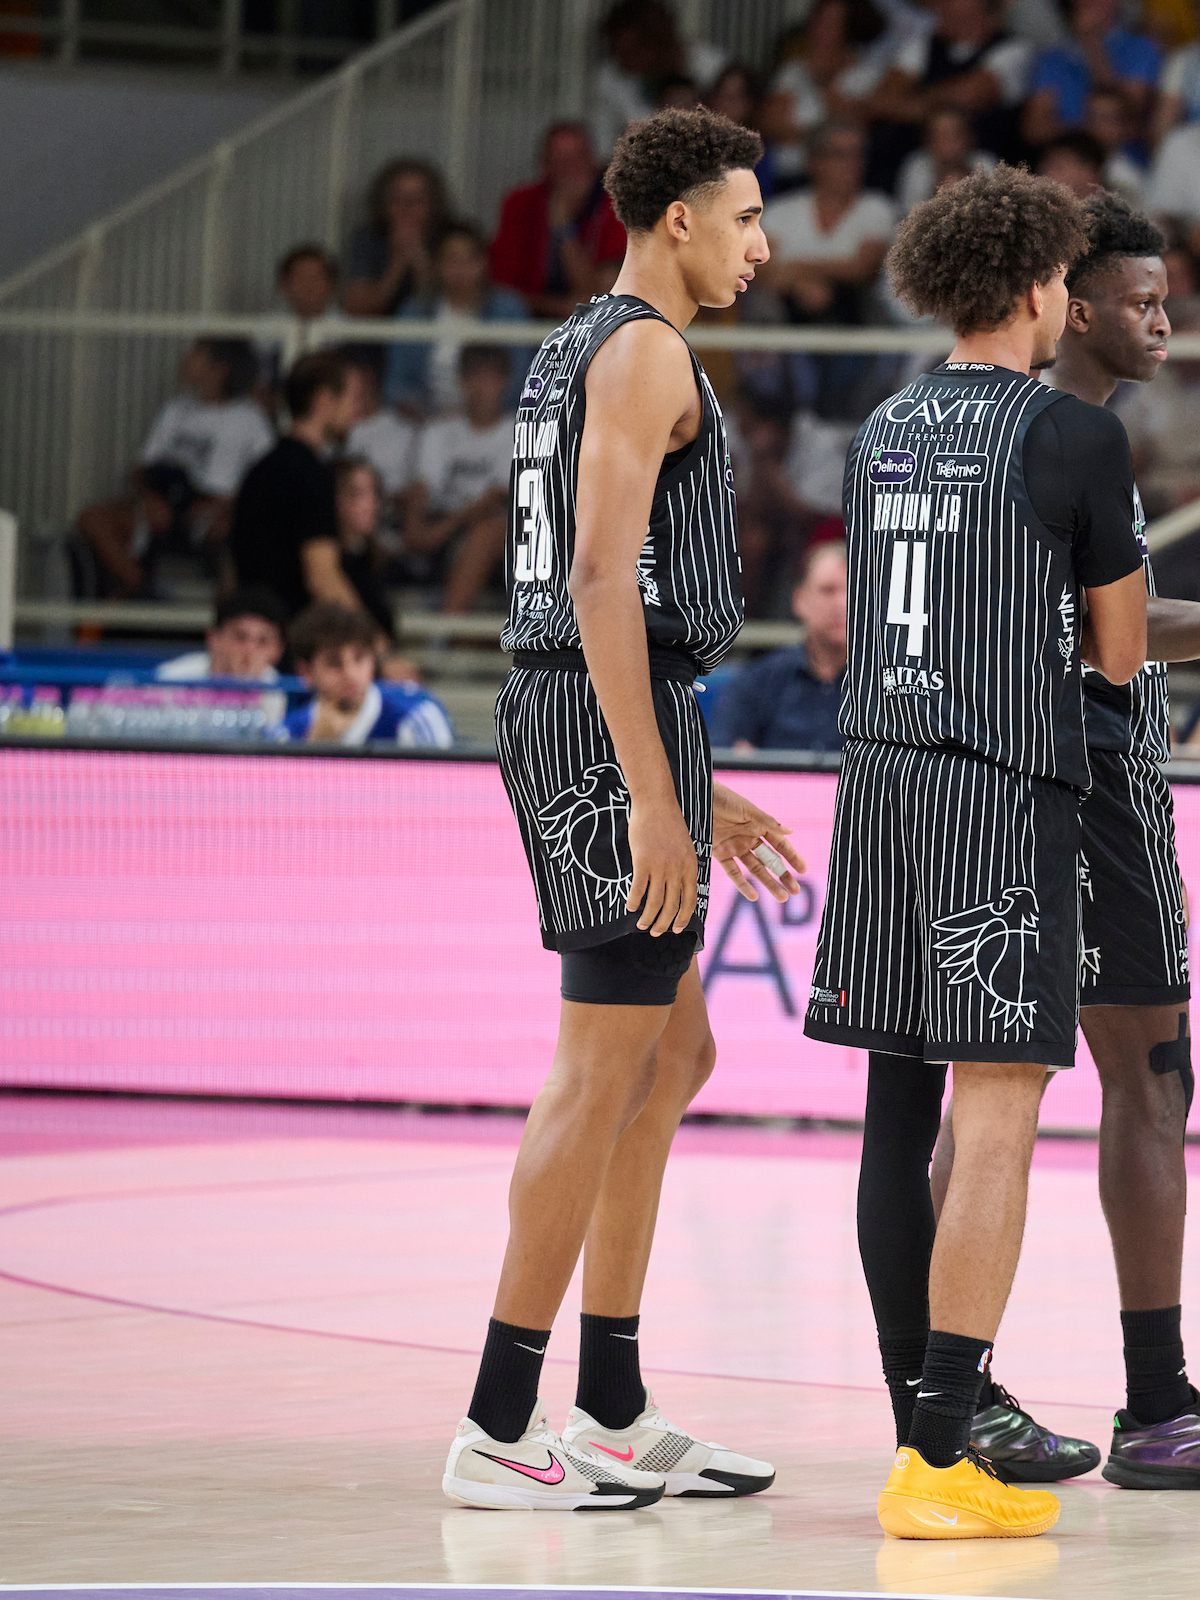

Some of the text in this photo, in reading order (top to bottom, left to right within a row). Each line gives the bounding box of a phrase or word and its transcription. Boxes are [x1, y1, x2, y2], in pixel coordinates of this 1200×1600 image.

[945, 363, 995, 372] NIKE PRO
[885, 398, 997, 426] CAVIT
[907, 432, 955, 442] TRENTO
[870, 456, 913, 474] Melinda
[936, 461, 981, 478] TRENTINO
[873, 493, 961, 533] BROWN JR
[886, 540, 929, 657] 4
[896, 667, 944, 691] ITAS
[898, 686, 931, 697] MUTUA
